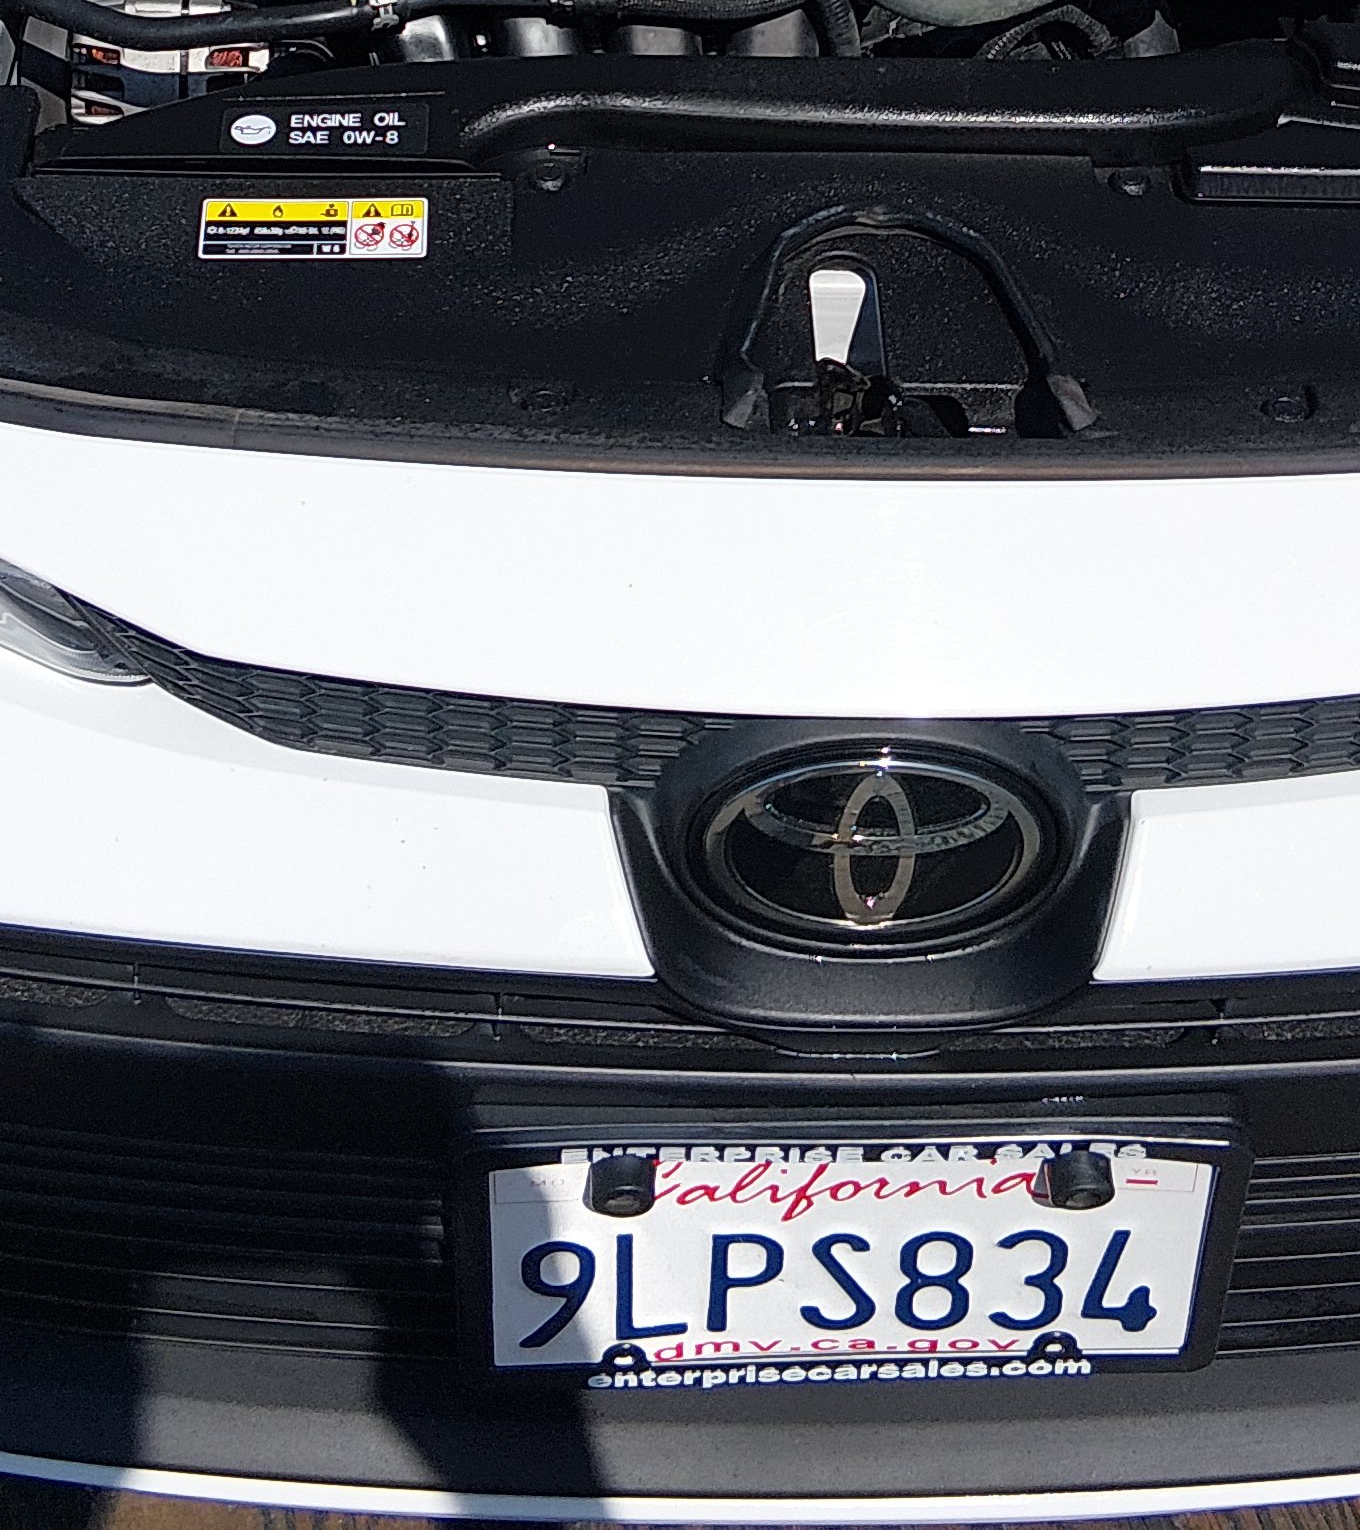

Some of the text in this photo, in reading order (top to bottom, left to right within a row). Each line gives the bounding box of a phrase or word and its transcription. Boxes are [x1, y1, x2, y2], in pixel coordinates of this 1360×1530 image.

[290, 112, 406, 128] ENGINE OIL
[288, 130, 399, 145] SAE 0W-8
[561, 1146, 864, 1164] ENTERPRISE
[880, 1145, 979, 1163] CAR
[519, 1230, 1158, 1348] 9LPS834
[653, 1338, 1021, 1362] dmv.ca.gov
[587, 1358, 1092, 1389] enterprisecarsales.com
